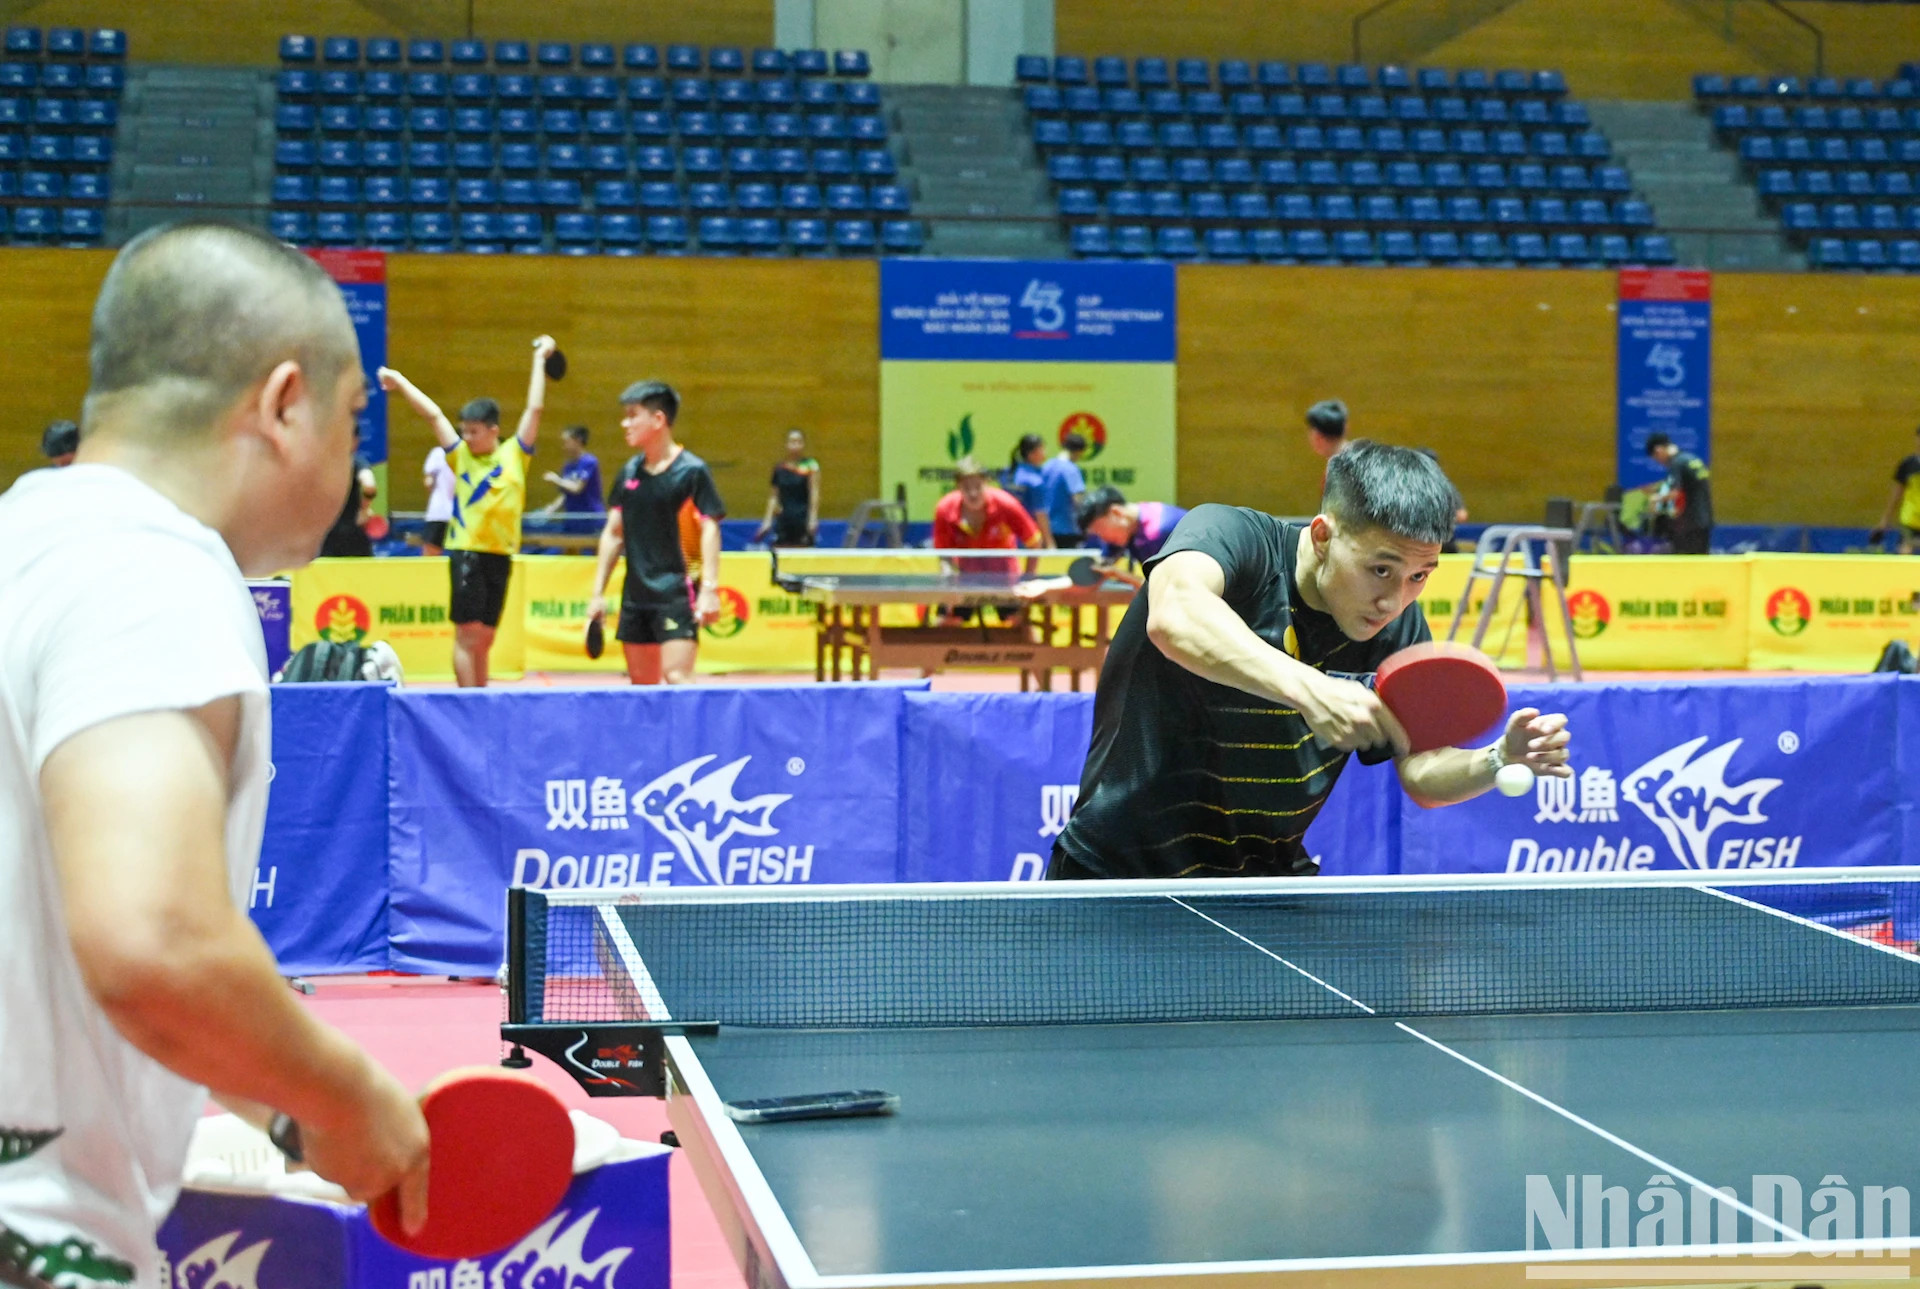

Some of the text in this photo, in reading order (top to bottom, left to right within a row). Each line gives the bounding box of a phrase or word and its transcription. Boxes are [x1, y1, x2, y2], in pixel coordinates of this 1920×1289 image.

[725, 845, 815, 885] FISH
[1505, 835, 1802, 873] Double FISH
